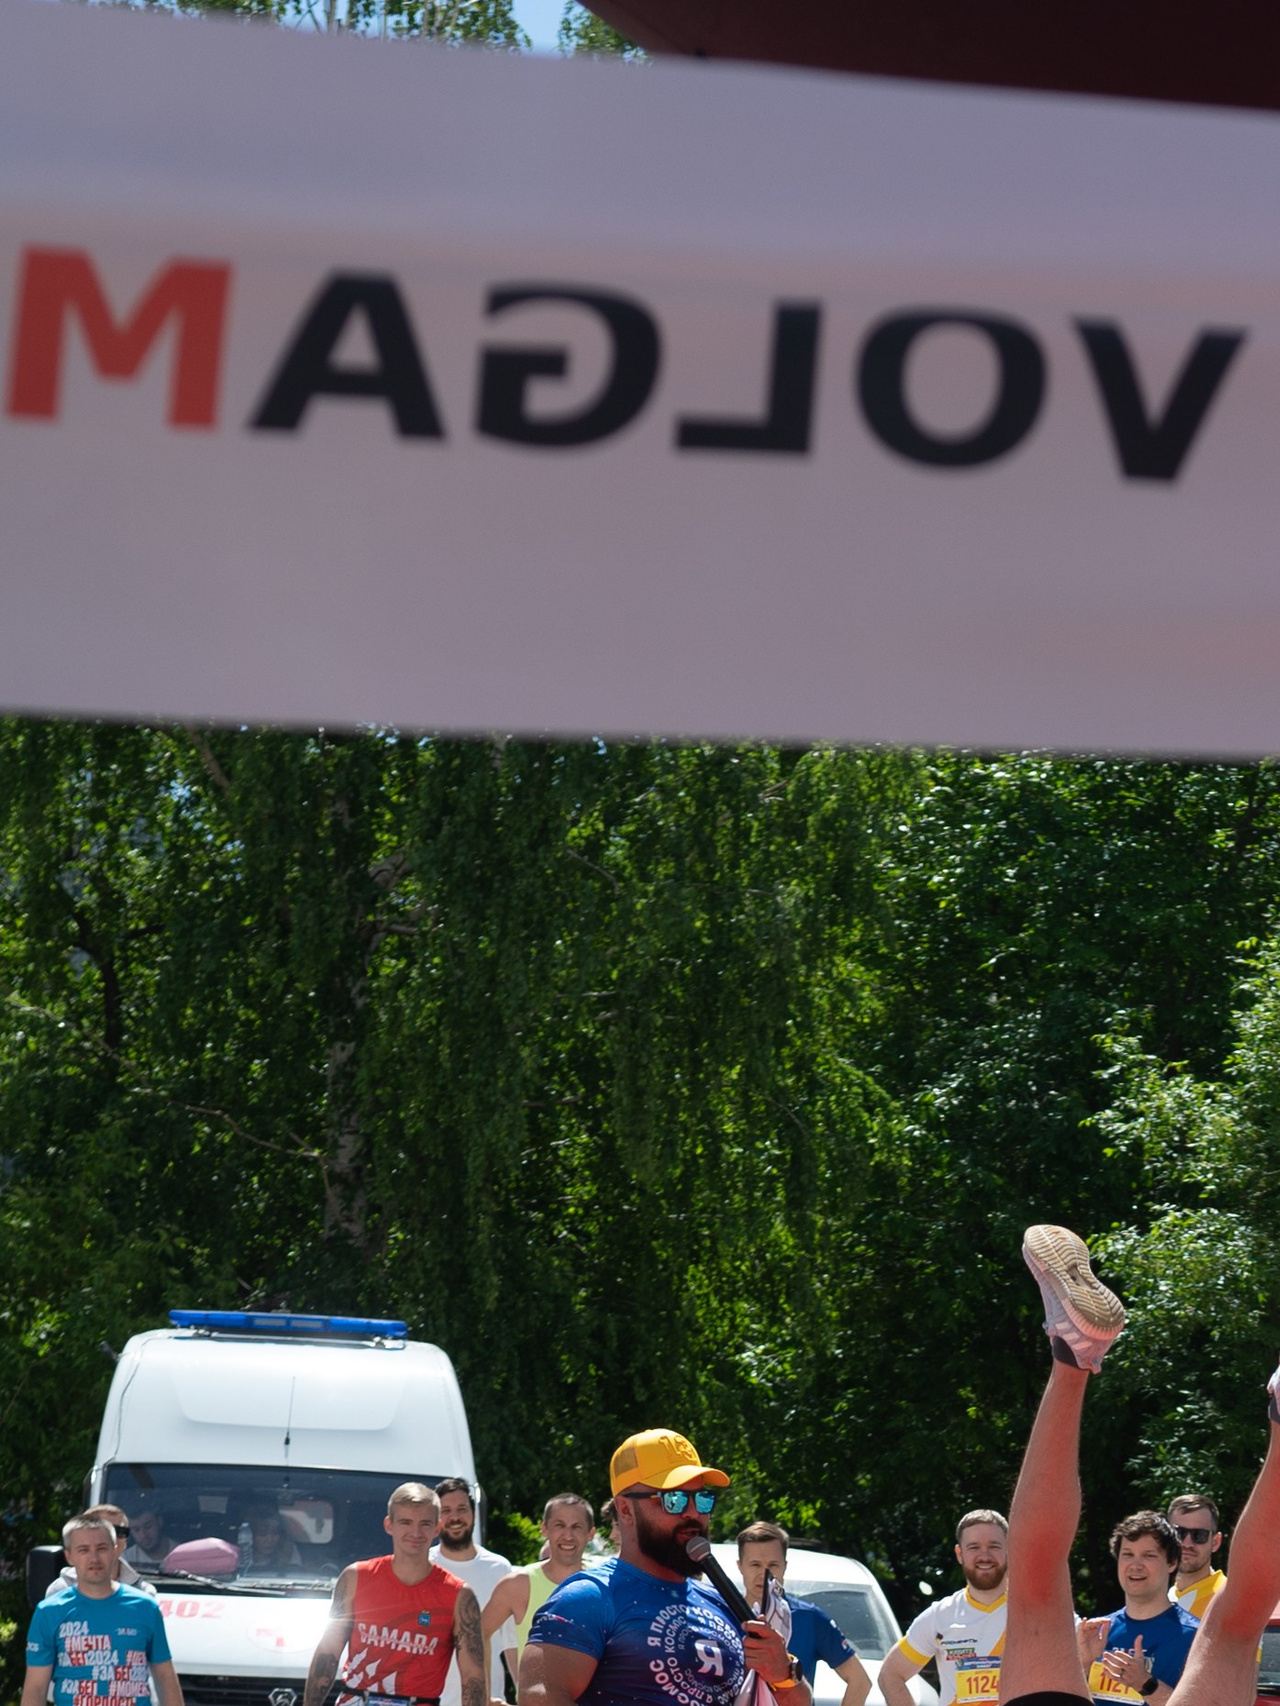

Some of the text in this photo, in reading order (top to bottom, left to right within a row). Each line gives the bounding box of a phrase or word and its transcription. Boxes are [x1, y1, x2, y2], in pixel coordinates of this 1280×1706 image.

[59, 1621, 89, 1638] 2024
[358, 1622, 438, 1655] SAMARA
[694, 1639, 724, 1678] Я
[966, 1675, 999, 1695] 1124
